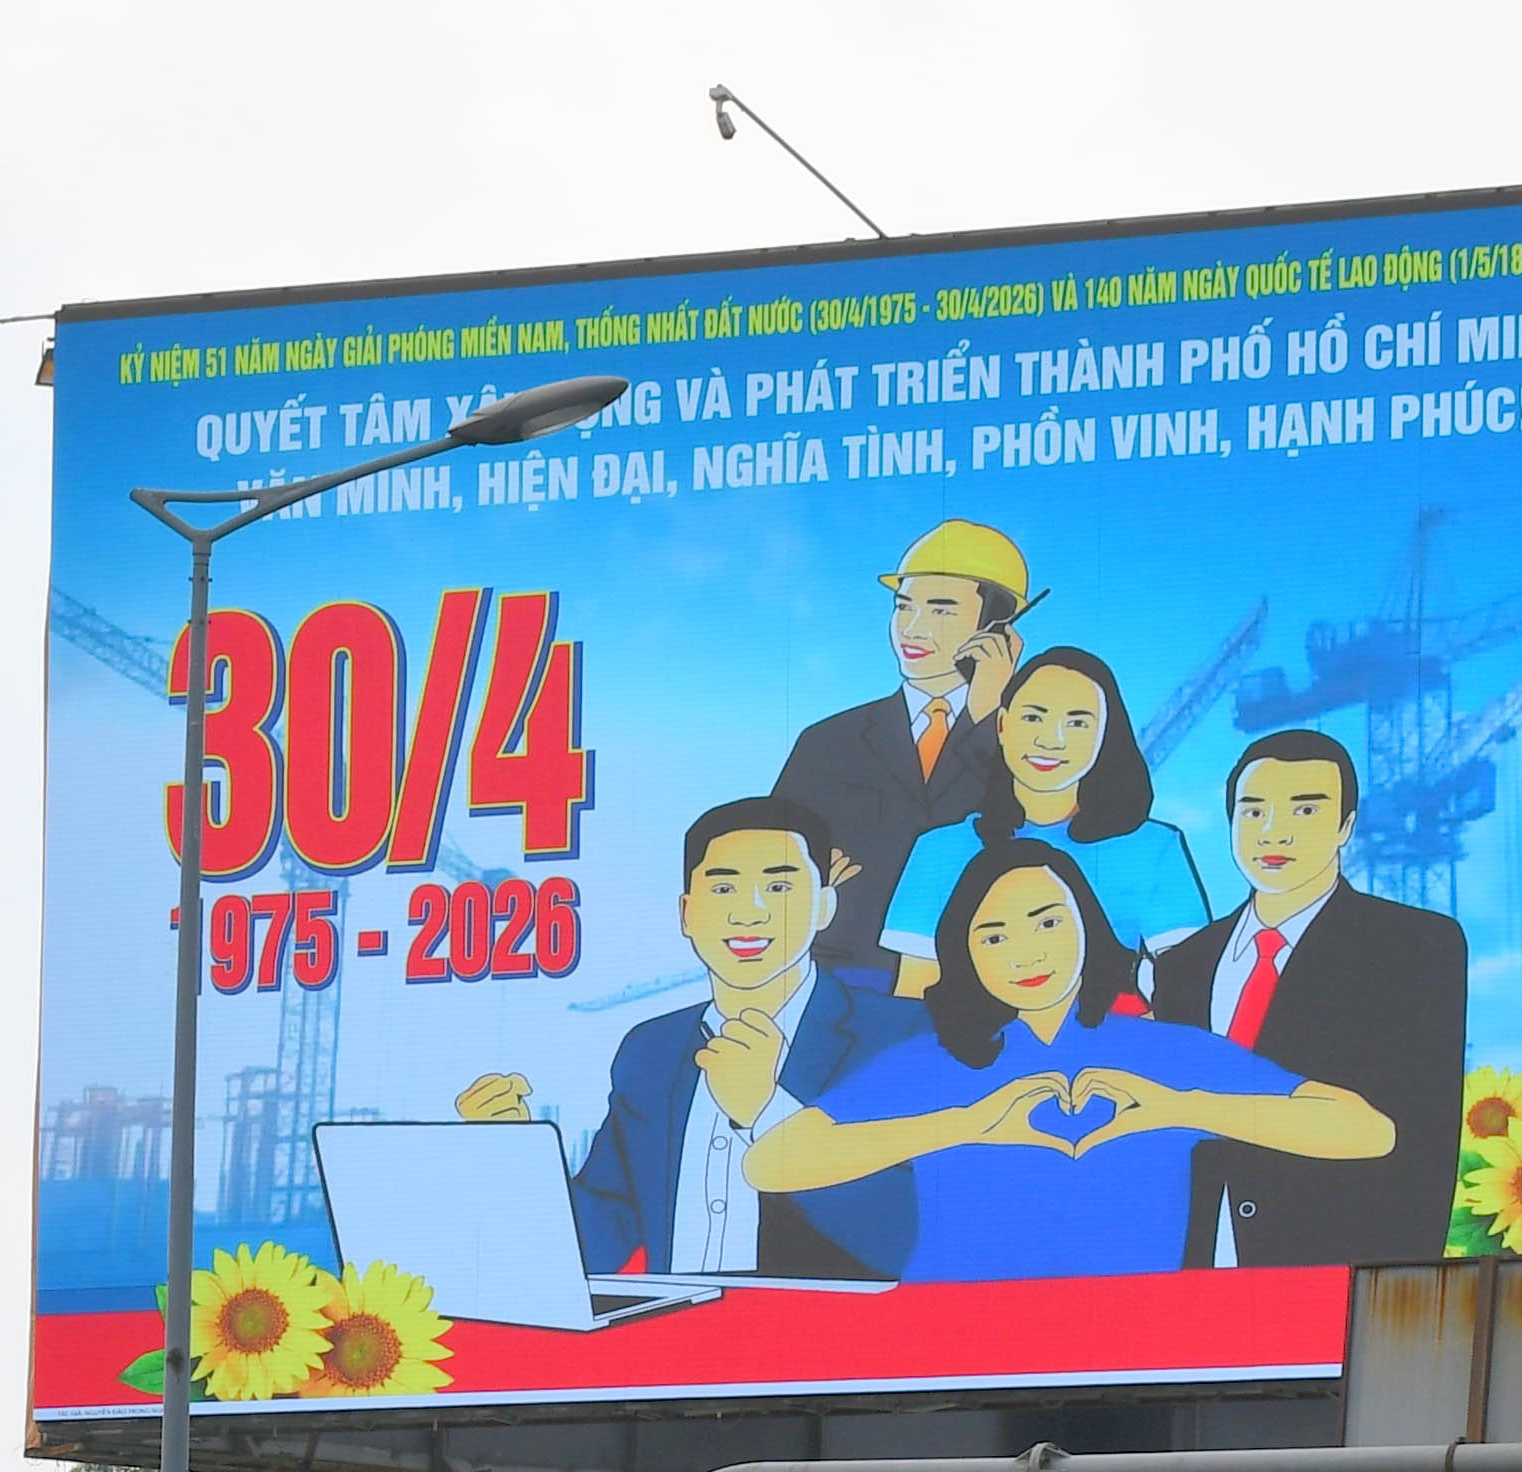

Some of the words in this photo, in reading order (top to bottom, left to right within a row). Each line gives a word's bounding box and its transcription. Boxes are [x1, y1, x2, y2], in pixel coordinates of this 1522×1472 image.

[120, 342, 145, 384] KỶ
[150, 343, 199, 387] NIỆM
[205, 347, 227, 378] 51
[235, 336, 280, 375] NĂM
[285, 332, 338, 371] NGÀY
[343, 324, 383, 367] GIẢI
[388, 324, 454, 364] PHÓNG
[460, 315, 512, 358] MIỀN
[517, 319, 569, 354] NAM,
[576, 305, 641, 349] THỐNG
[646, 299, 699, 344] NHẤT
[704, 295, 743, 339] ĐẤT
[748, 296, 803, 335] NƯỚC
[810, 292, 916, 335] (30/4/1975
[936, 282, 1045, 322] 30/4/2026)
[1051, 273, 1078, 311] VÀ
[1085, 276, 1122, 309] 140
[1128, 266, 1177, 306] NĂM
[1183, 259, 1238, 303] NGÀY
[1245, 250, 1302, 299] QUỐC
[1307, 247, 1332, 292] TẾ
[1338, 254, 1378, 289] LAO
[1383, 244, 1442, 292] ĐỘNG
[195, 394, 327, 460] QUYẾT
[339, 391, 432, 450] TÂM
[676, 368, 732, 422] VÀ
[745, 359, 859, 417] PHÁT
[872, 338, 1000, 407] TRIỂN
[1015, 338, 1165, 397] THÀNH
[1180, 317, 1274, 385] PHỐ
[1287, 312, 1348, 376] HỒ
[1364, 310, 1443, 371] CHÍ
[336, 465, 463, 517] MINH,
[478, 450, 578, 512] HIỆN
[591, 449, 678, 504] ĐẠI,
[693, 431, 829, 491] NGHĨA
[843, 425, 957, 480] TÌNH,
[972, 405, 1096, 471] PHỒN
[1111, 408, 1232, 460] VINH,
[1247, 397, 1375, 458] HẠNH
[164, 587, 595, 882] 30/4
[170, 890, 338, 996] 975
[405, 876, 580, 983] 2026
